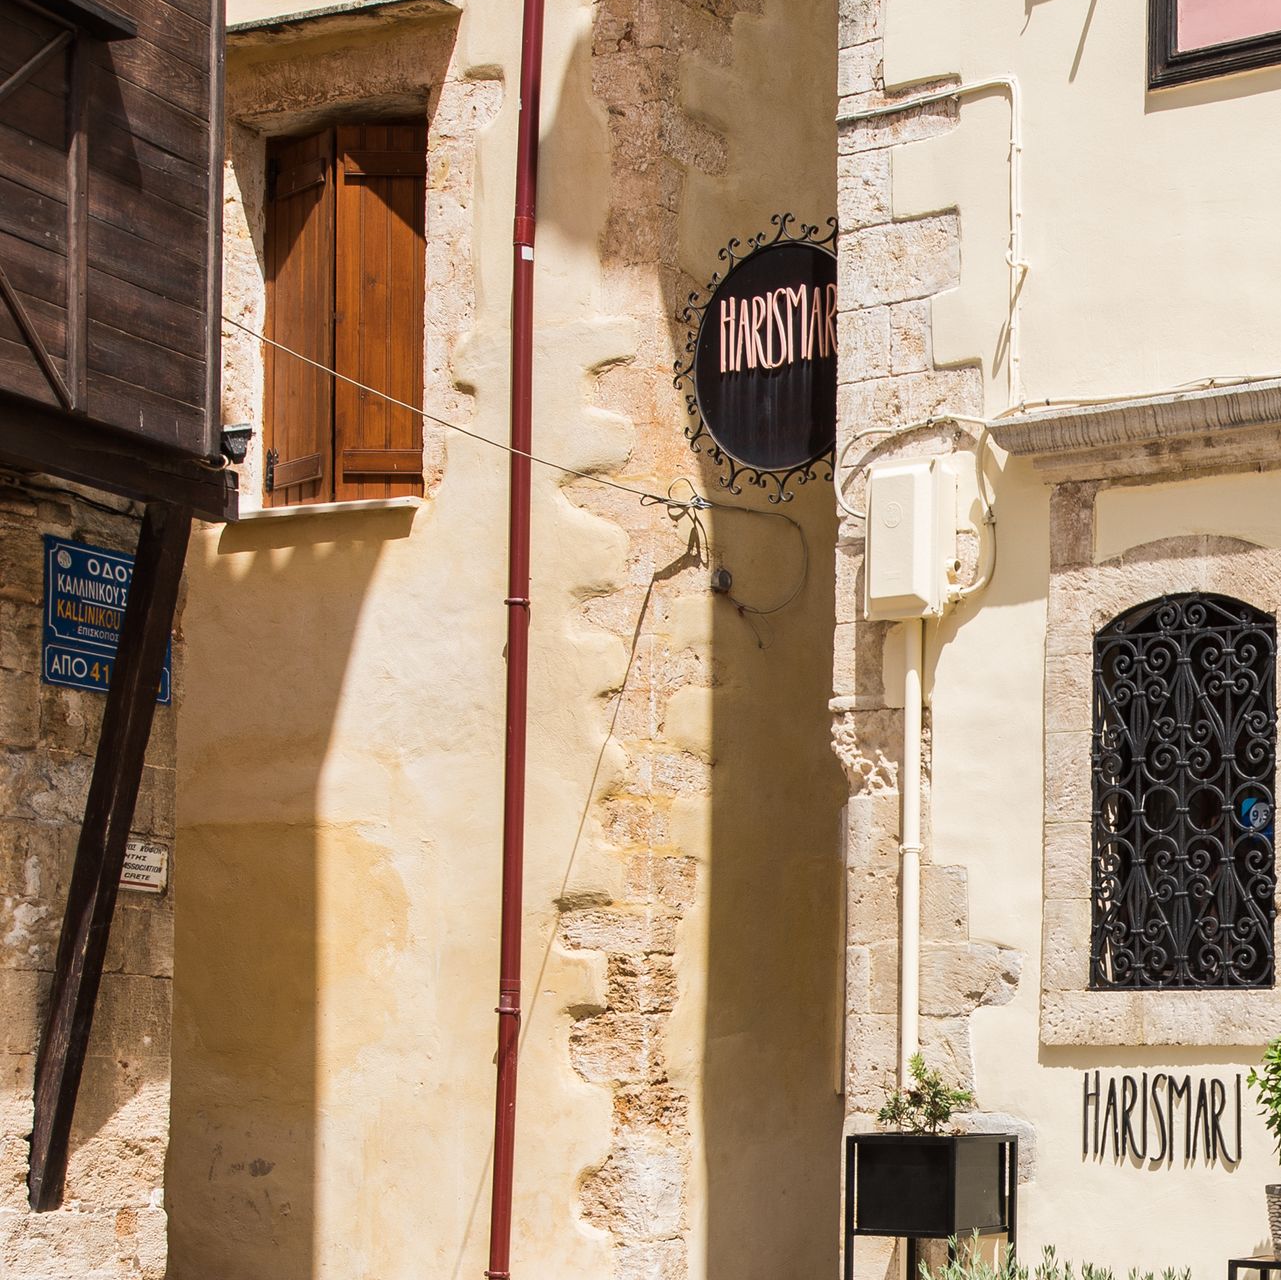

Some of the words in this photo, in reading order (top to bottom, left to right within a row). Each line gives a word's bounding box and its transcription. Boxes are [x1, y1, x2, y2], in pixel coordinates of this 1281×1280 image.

[720, 283, 838, 373] HARISMAR
[57, 573, 120, 606] ΚΑΛΛΙΝΙΚΟΥ
[57, 599, 121, 631] KALLINIKOU
[51, 654, 88, 679] ΑΠΟ
[89, 662, 110, 685] 41
[124, 872, 150, 880] CRETE
[1083, 1070, 1242, 1164] HARISMARI
